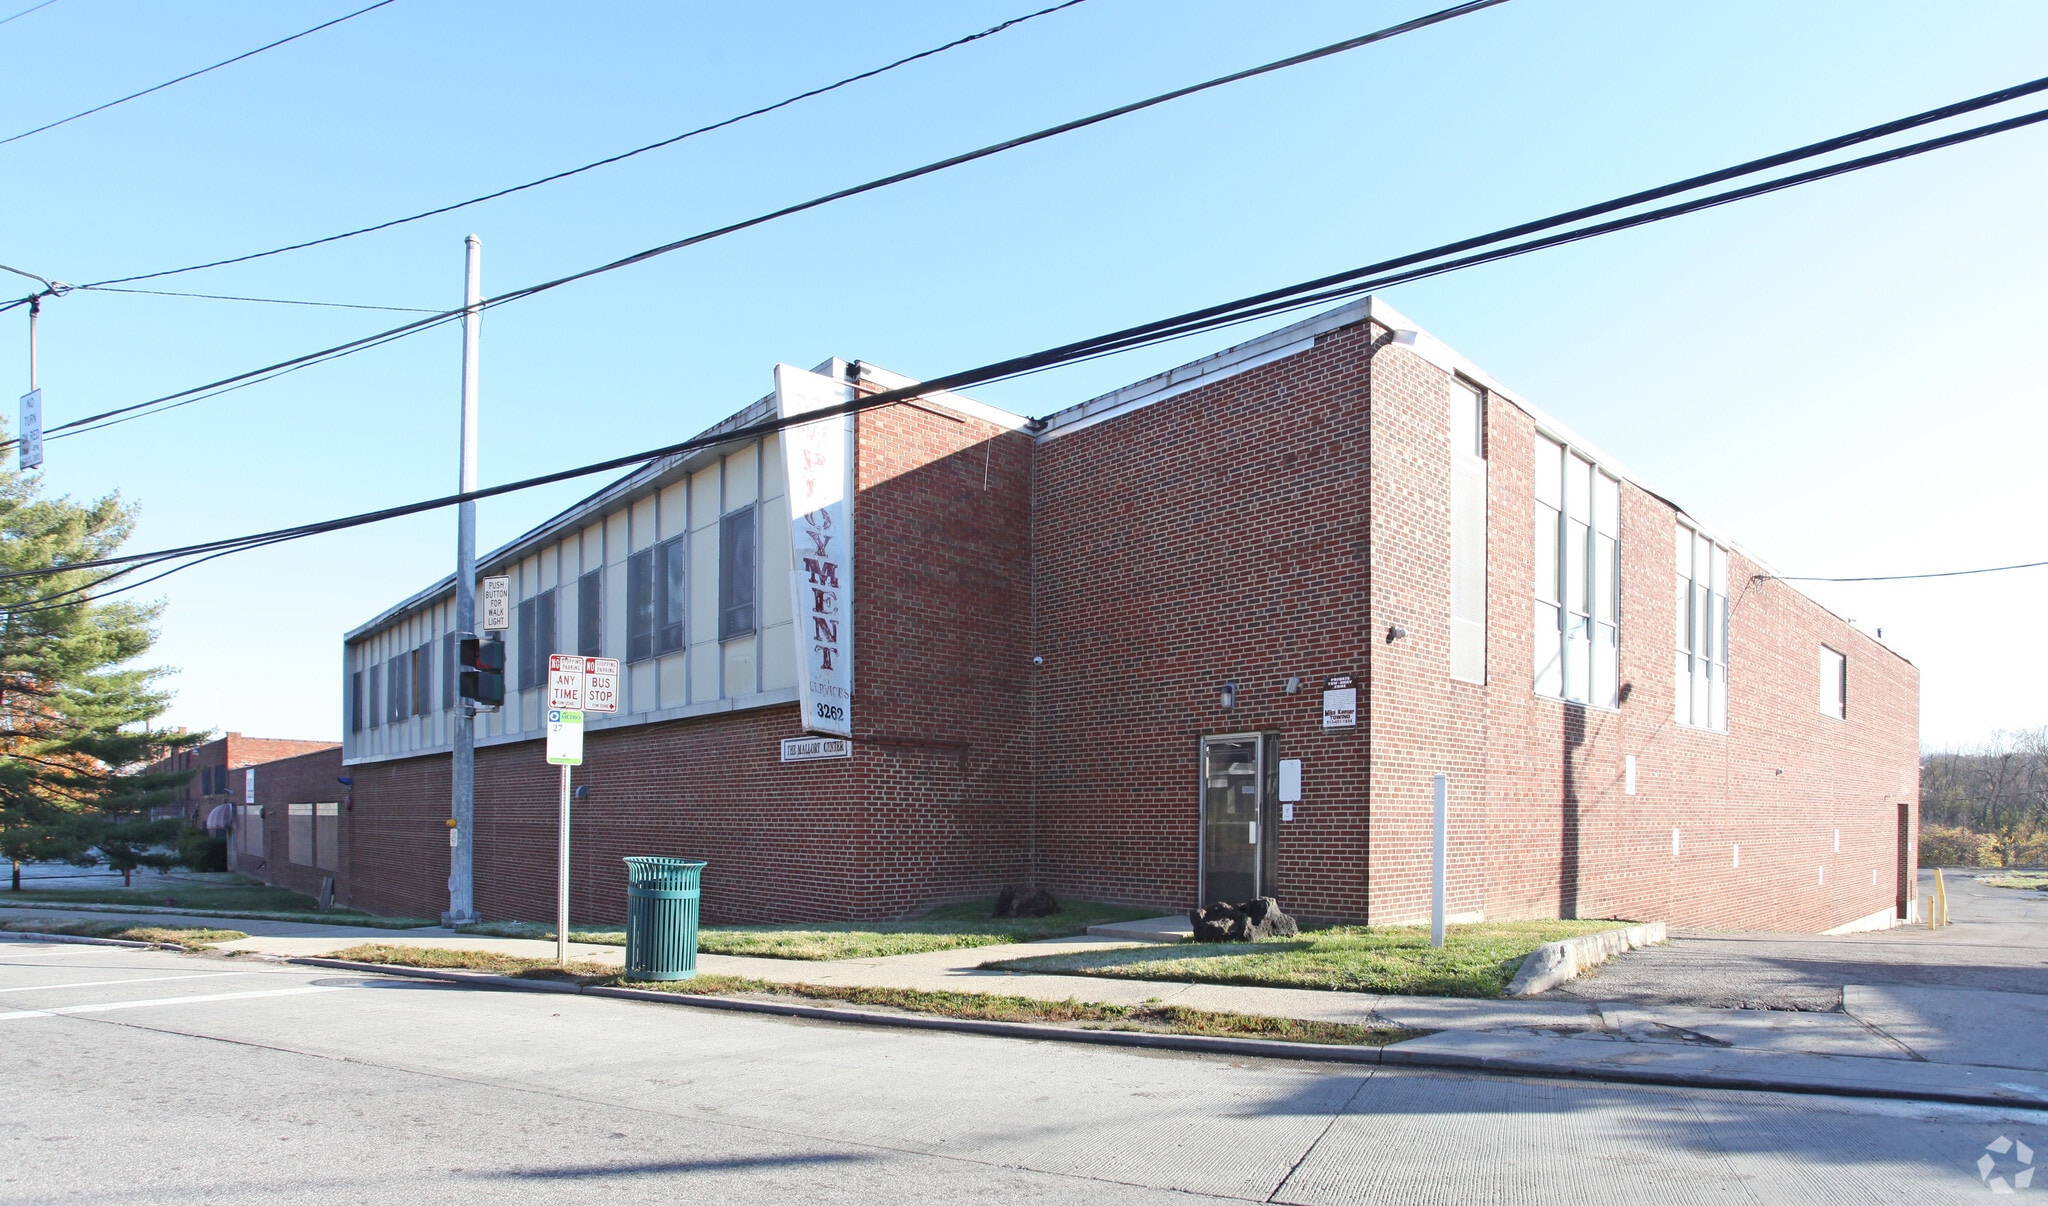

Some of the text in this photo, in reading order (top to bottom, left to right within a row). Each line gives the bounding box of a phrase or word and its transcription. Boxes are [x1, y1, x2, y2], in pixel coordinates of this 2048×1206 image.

[27, 397, 34, 409] NO
[24, 413, 37, 427] TURN
[30, 428, 39, 441] RED
[488, 581, 504, 590] PUSH
[486, 590, 507, 599] BUTTON
[491, 599, 501, 607] FOR
[488, 609, 504, 617] WALK
[488, 617, 504, 626] LIGHT
[551, 658, 560, 669] NO
[586, 661, 595, 671] NO
[558, 675, 575, 685] ANY
[592, 677, 610, 688] BUS
[554, 688, 578, 700] TIME
[589, 690, 612, 701] STOP
[809, 681, 850, 699] SERVICES
[816, 702, 844, 721] 3262
[787, 740, 844, 755] THE MALLORY CENTER
